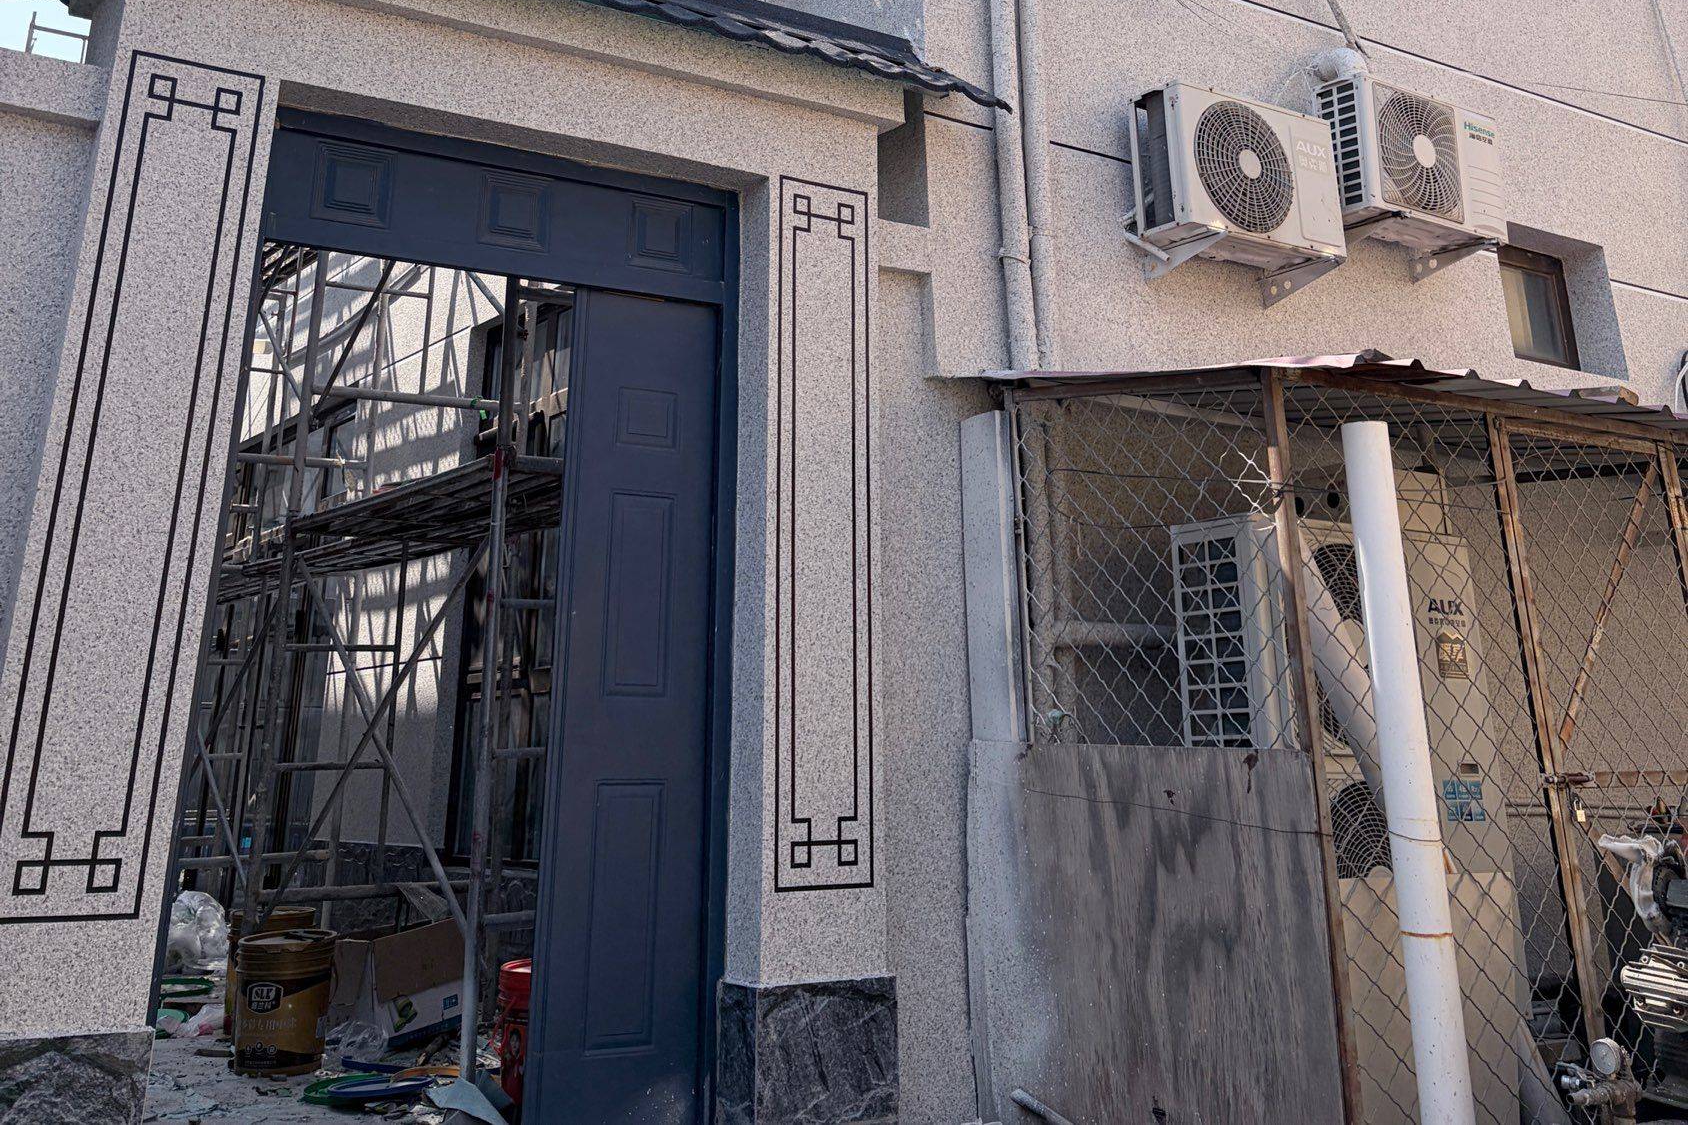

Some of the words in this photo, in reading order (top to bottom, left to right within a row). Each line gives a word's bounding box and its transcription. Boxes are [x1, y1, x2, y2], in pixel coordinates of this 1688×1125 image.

[1463, 121, 1496, 138] Hisense
[1296, 140, 1327, 159] AUX
[1428, 598, 1464, 616] AUX
